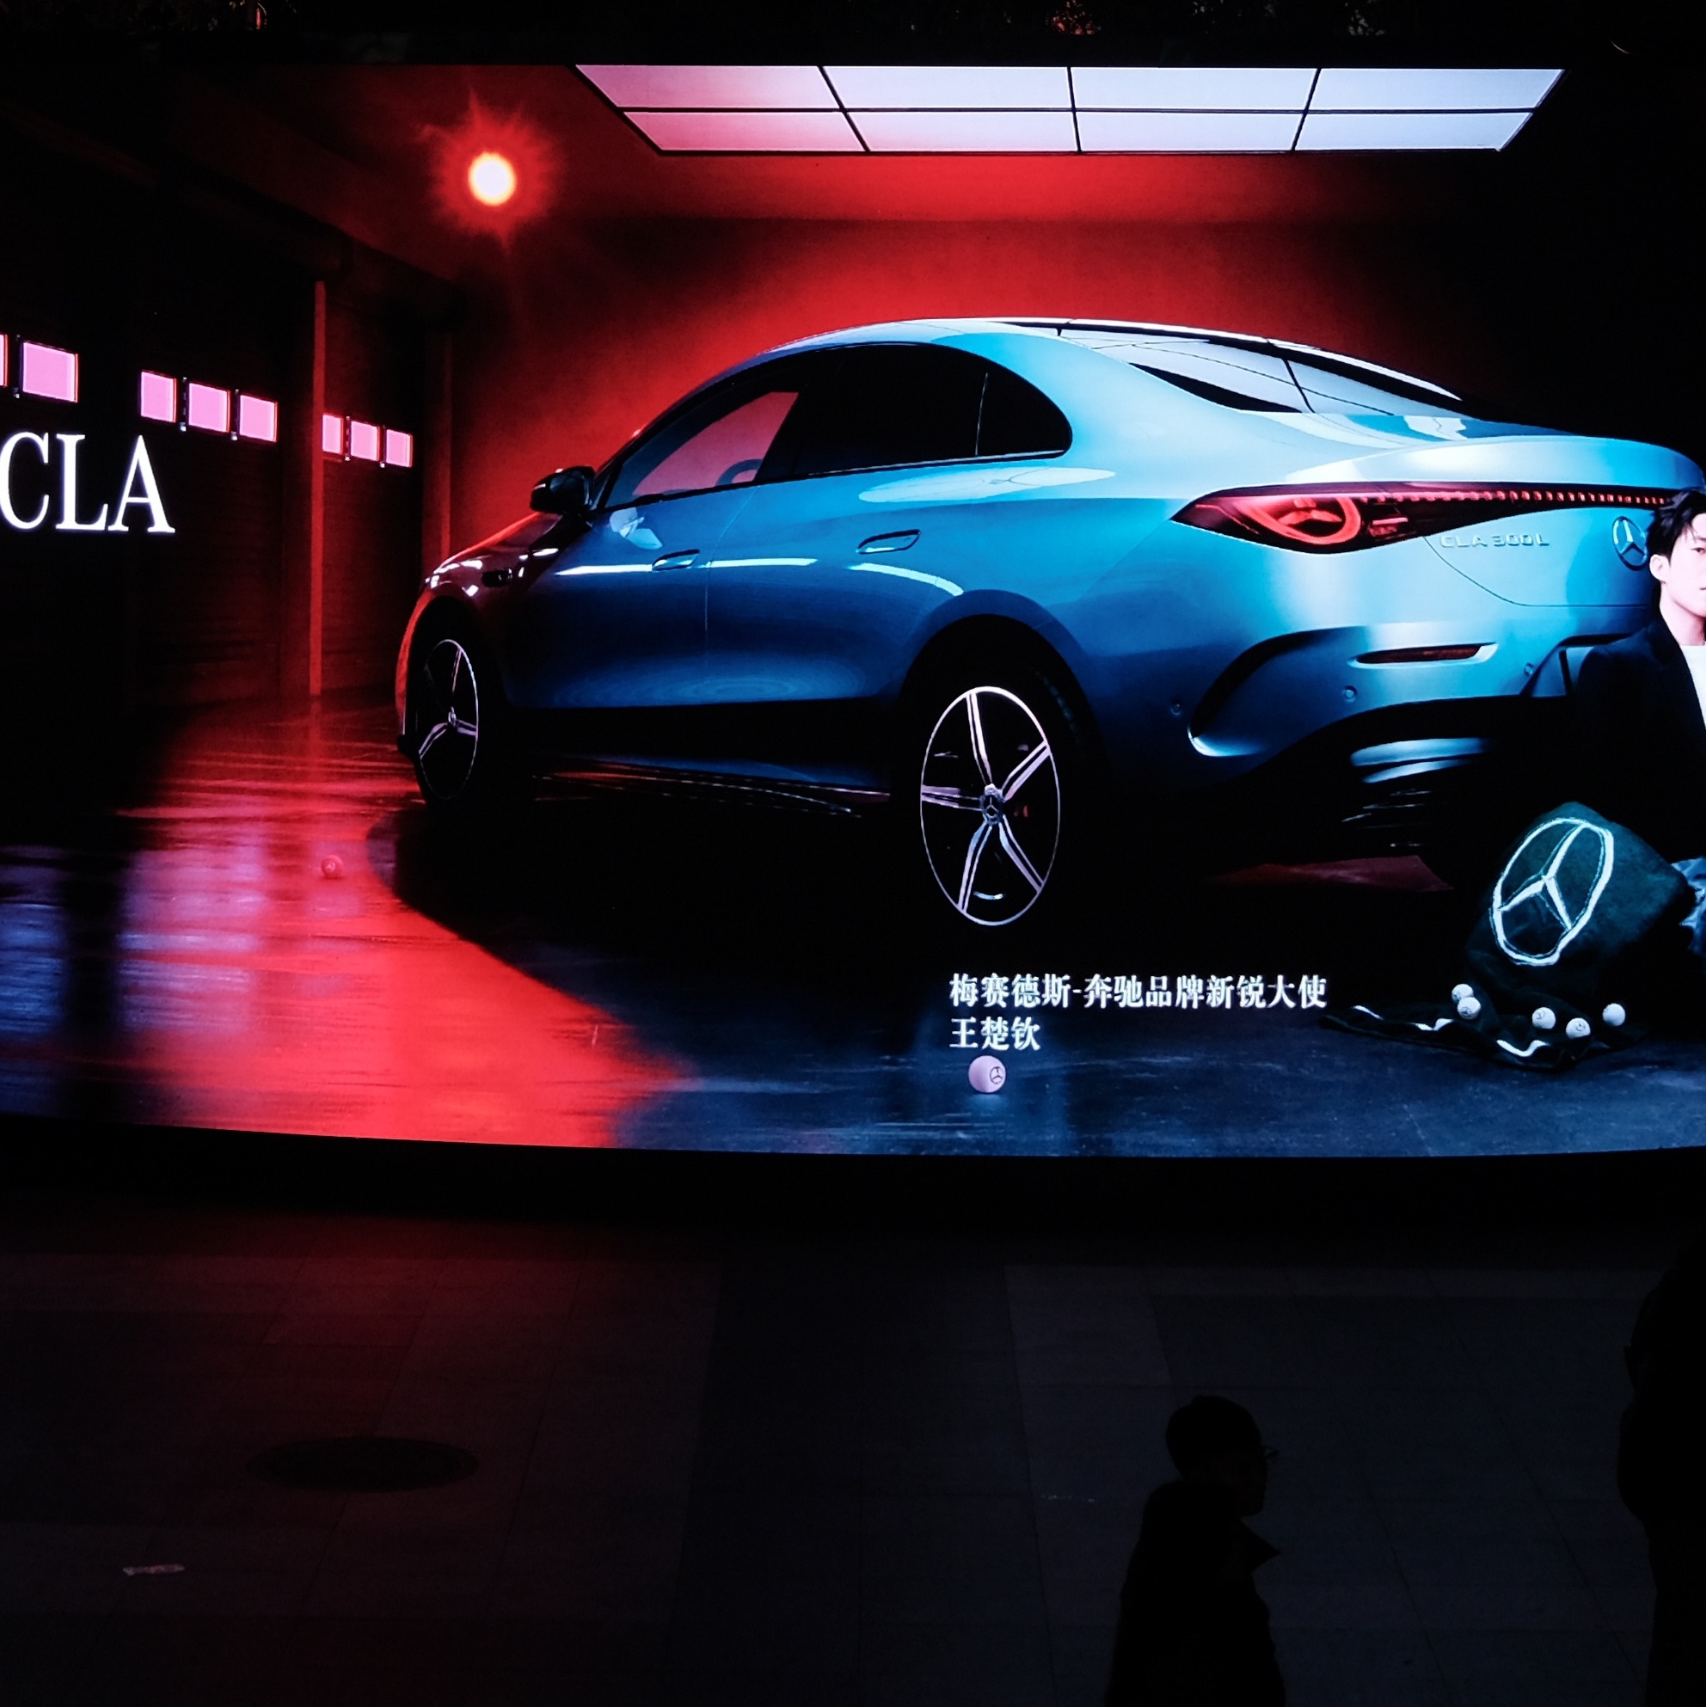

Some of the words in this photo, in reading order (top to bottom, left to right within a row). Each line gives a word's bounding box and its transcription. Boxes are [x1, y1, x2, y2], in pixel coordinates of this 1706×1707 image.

[1439, 532, 1488, 548] CLA
[949, 972, 1327, 1010] 梅赛德斯-奔驰品牌新锐大使
[949, 1016, 1041, 1051] 王楚钦
